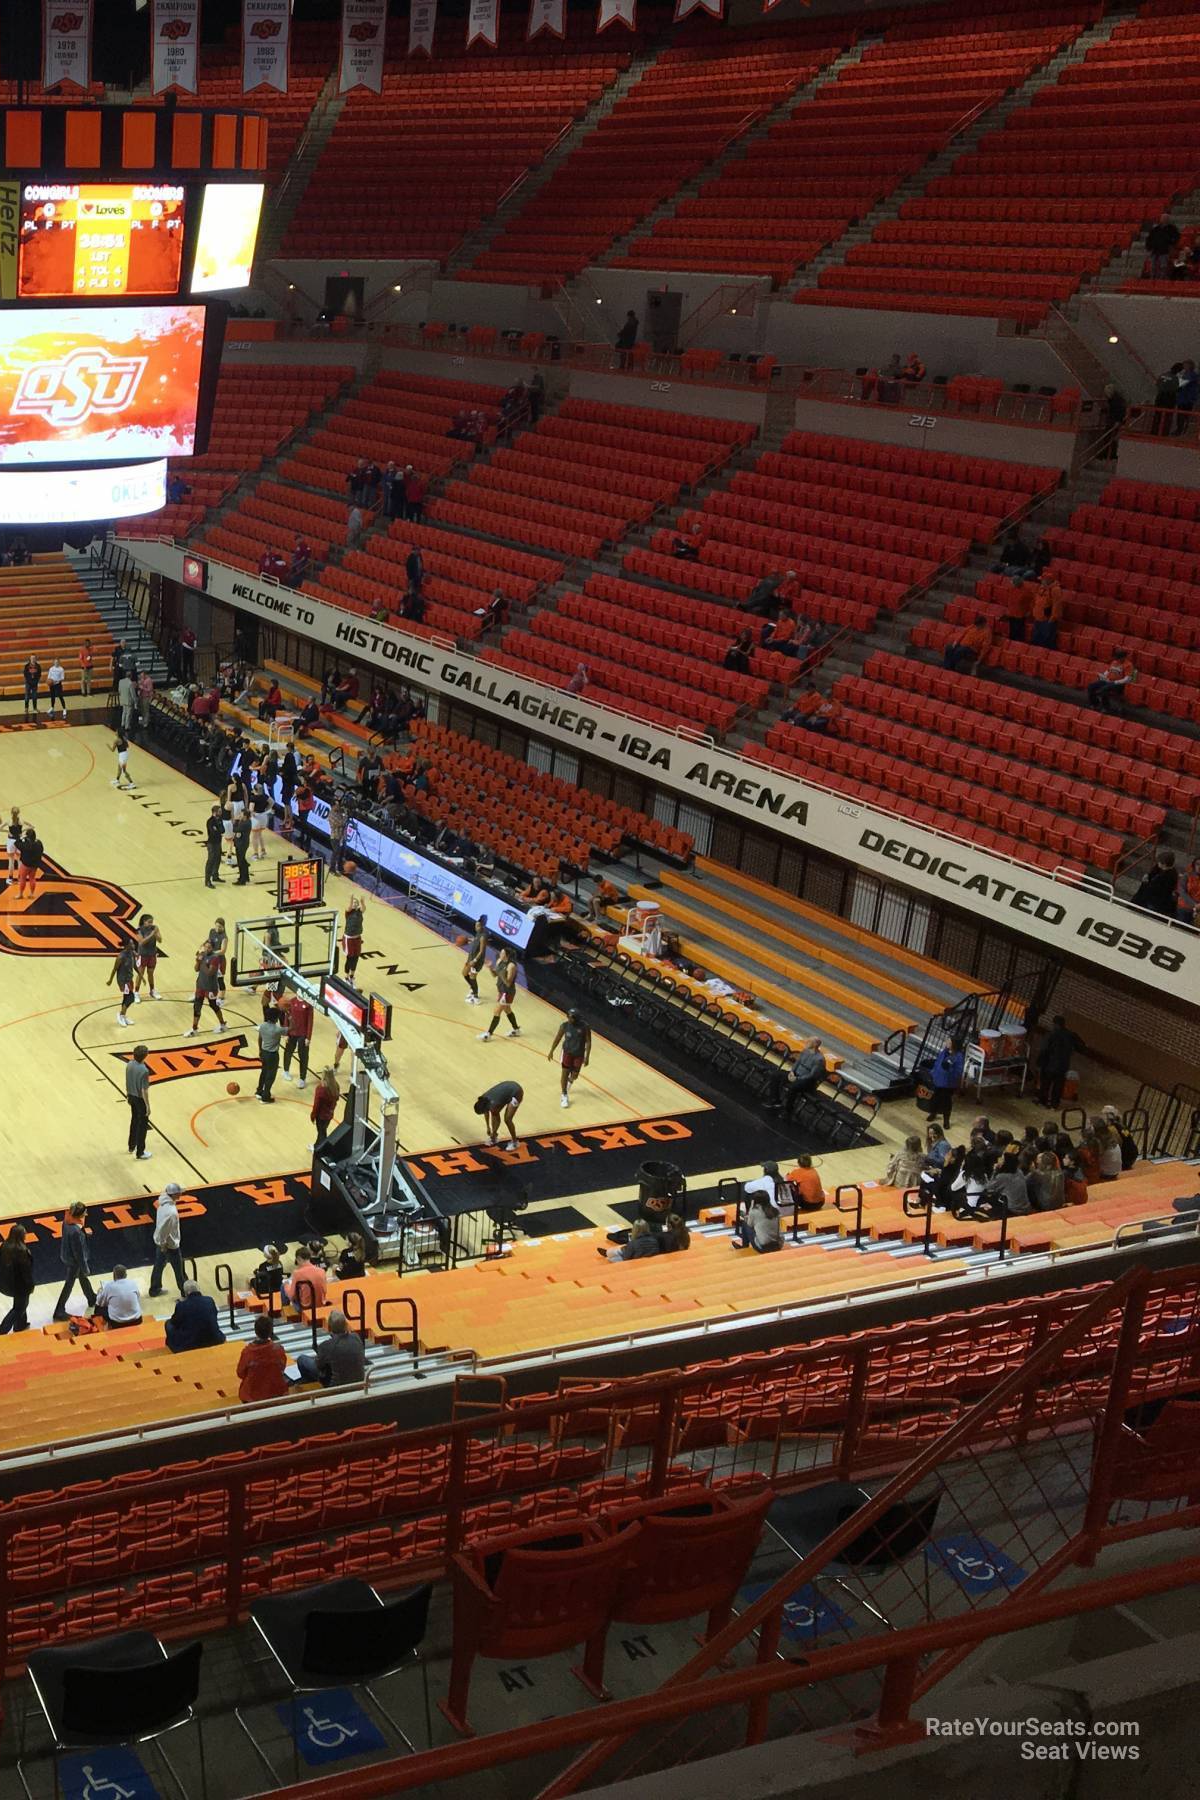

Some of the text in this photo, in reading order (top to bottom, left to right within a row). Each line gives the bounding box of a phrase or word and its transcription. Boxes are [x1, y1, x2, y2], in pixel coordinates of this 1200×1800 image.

[156, 2, 196, 11] CHAMPIONS
[246, 2, 287, 11] CHAMPIONS
[57, 41, 76, 50] 1978
[0, 186, 17, 257] Hertz
[24, 221, 76, 231] PL F PT
[131, 220, 143, 230] PL
[167, 220, 182, 230] PT
[9, 346, 147, 427] OSU
[650, 381, 672, 392] 212
[909, 414, 937, 428] 213
[232, 583, 1188, 974] WELCOME TO HISTORIC GALLAGHER-IBA ARENA DEDICATED 1938
[284, 863, 317, 879] 38:51
[620, 1635, 658, 1662] AT
[499, 1665, 536, 1693] AT
